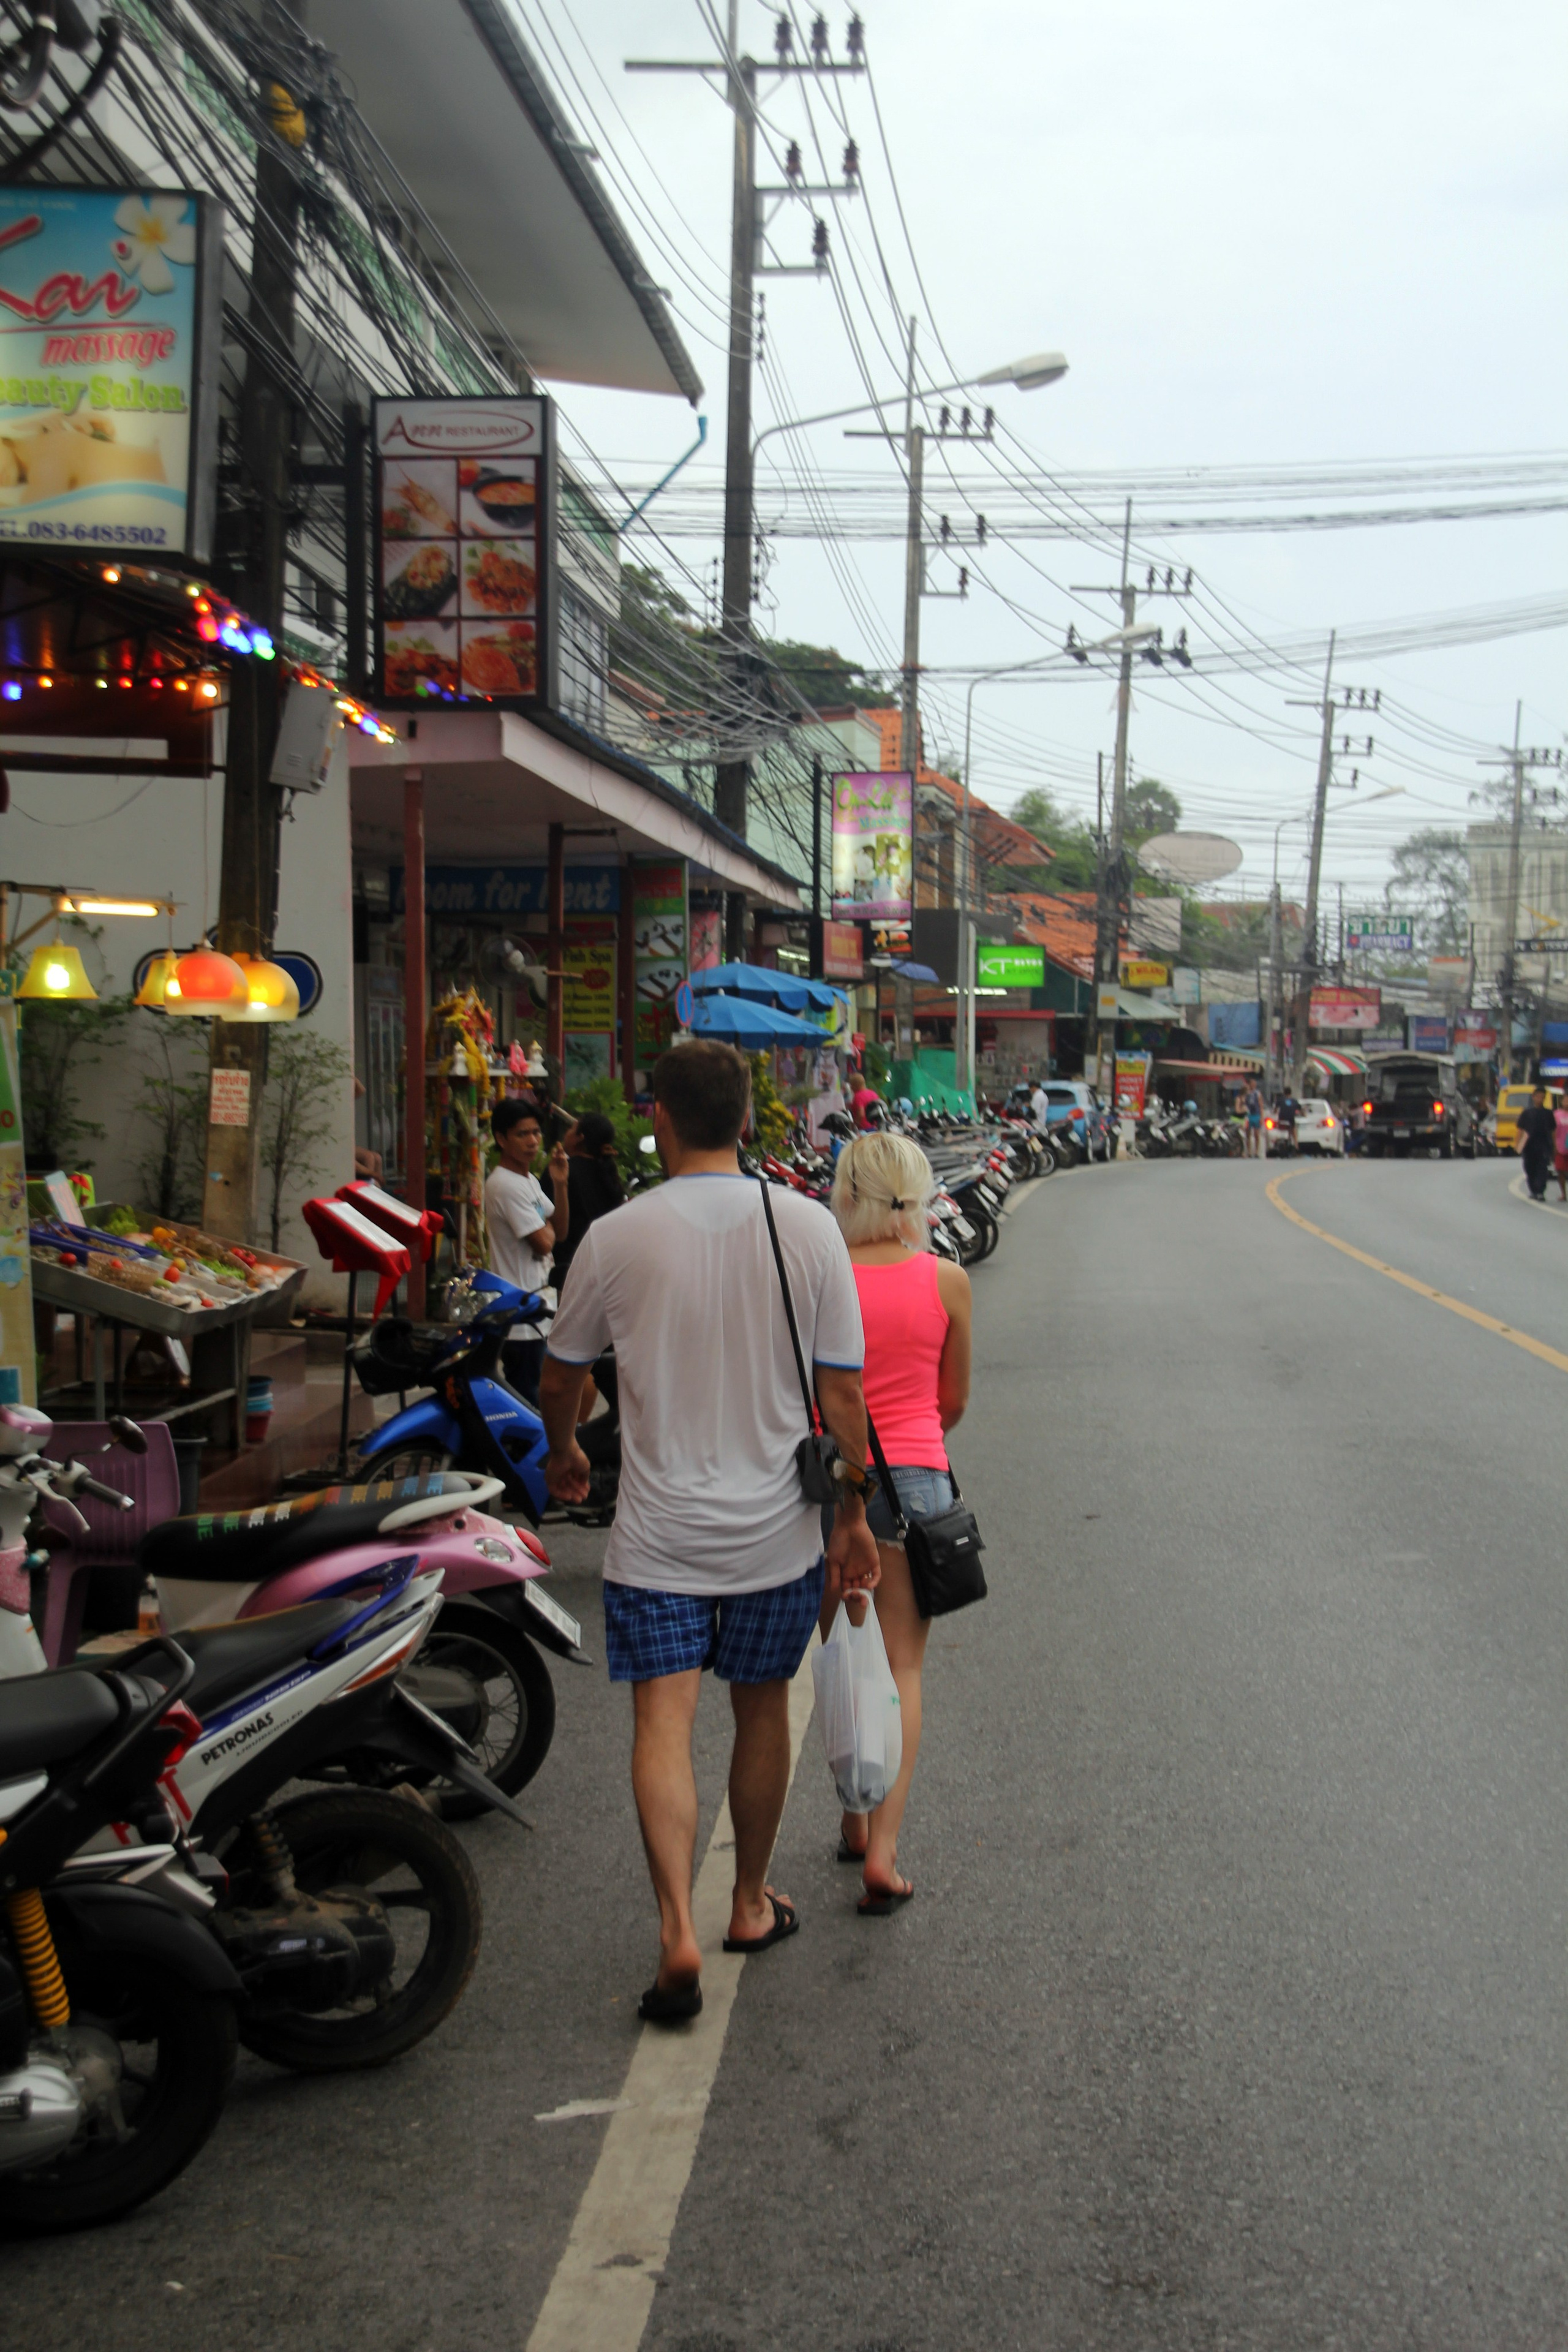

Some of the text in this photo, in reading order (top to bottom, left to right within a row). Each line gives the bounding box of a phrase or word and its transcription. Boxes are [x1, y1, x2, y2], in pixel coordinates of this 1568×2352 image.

[42, 328, 176, 370] massage
[90, 373, 186, 412] Salon
[445, 425, 518, 438] RESTAURANT
[485, 870, 530, 910] for
[1359, 935, 1409, 950] PHARMACY
[589, 949, 612, 965] Spa
[485, 1411, 518, 1422] HONDA
[201, 1712, 274, 1766] PETRONAS
